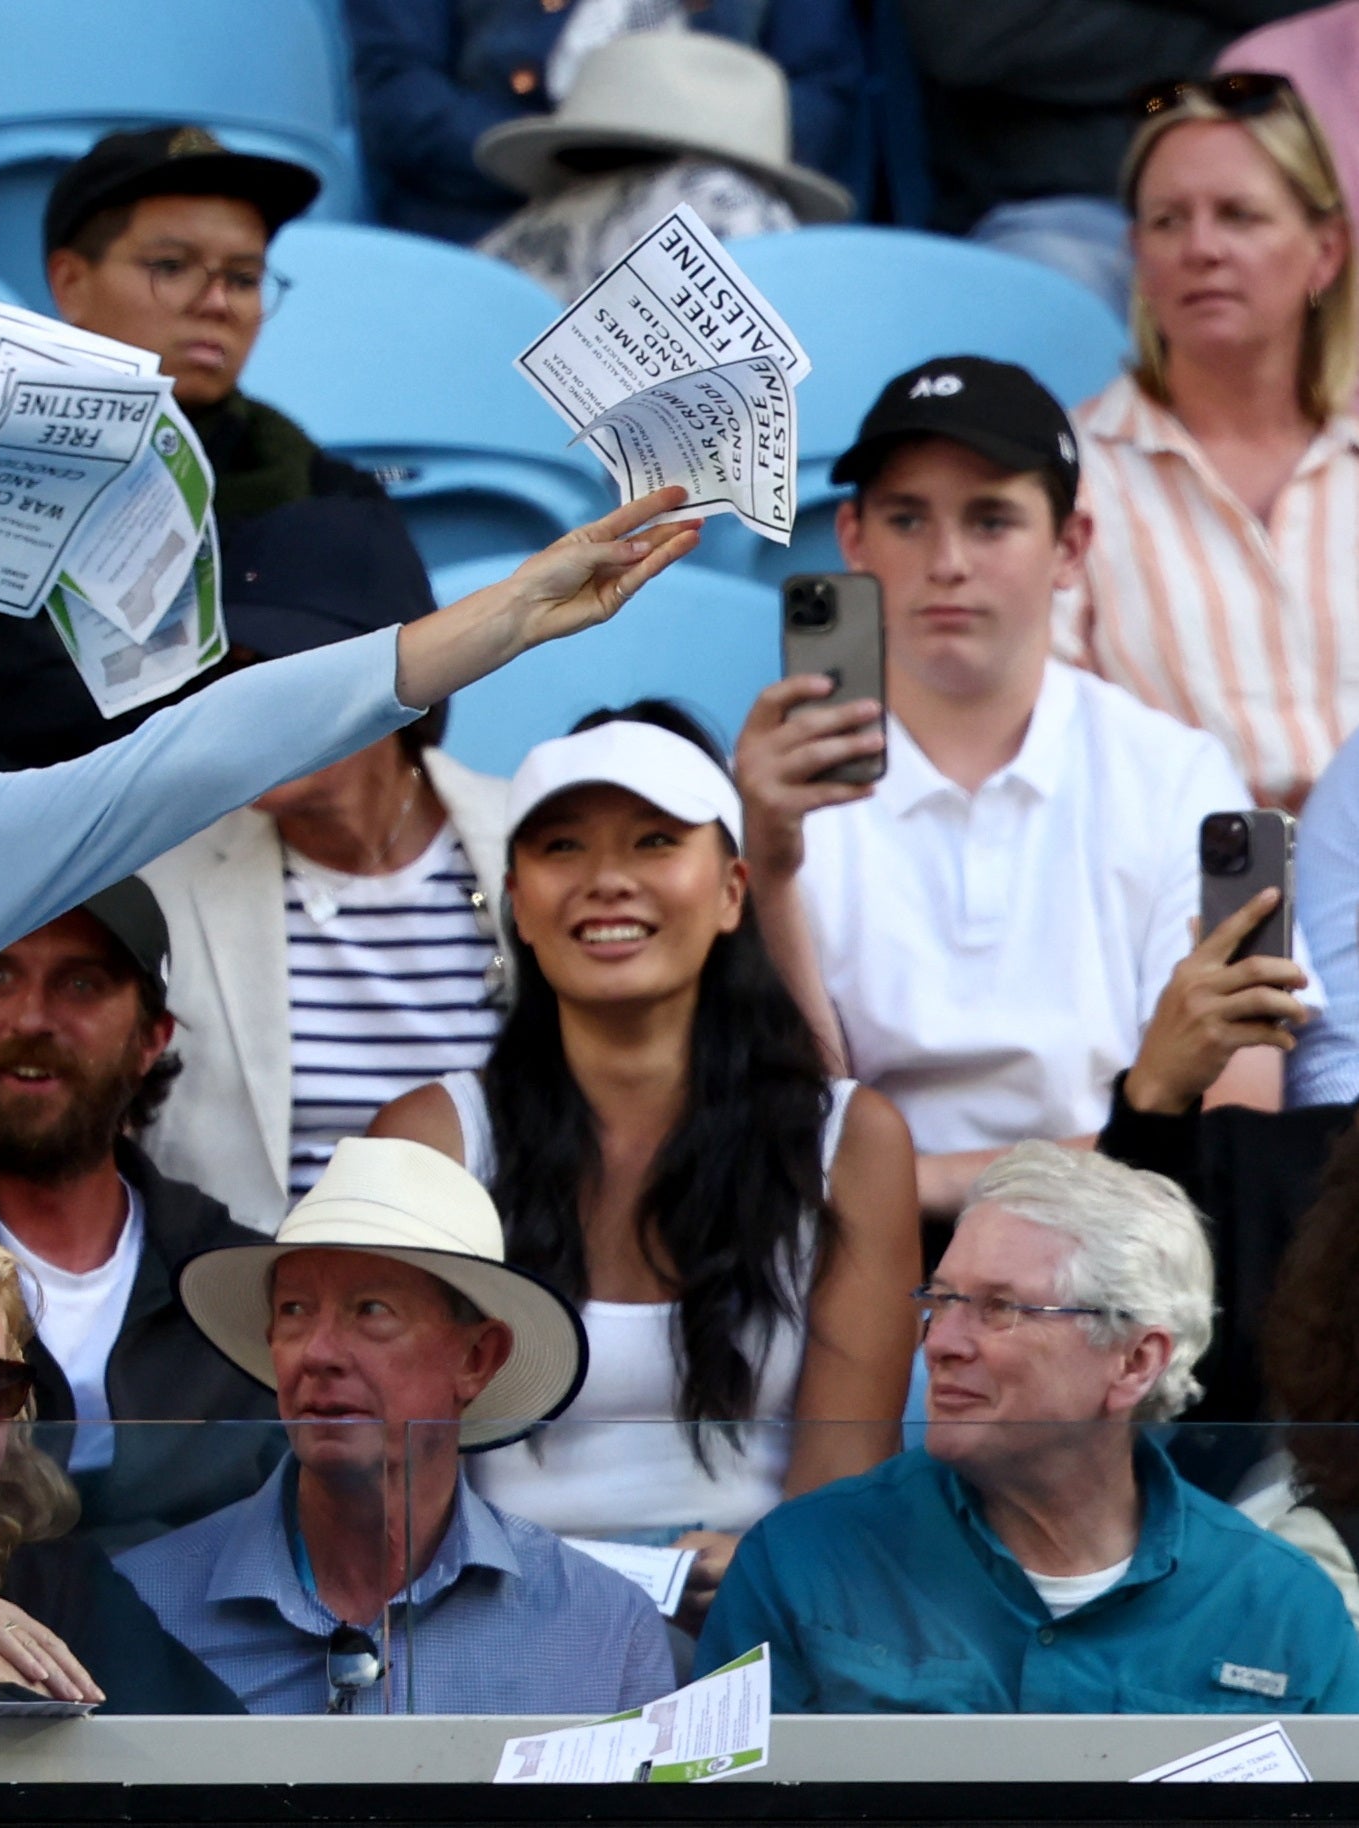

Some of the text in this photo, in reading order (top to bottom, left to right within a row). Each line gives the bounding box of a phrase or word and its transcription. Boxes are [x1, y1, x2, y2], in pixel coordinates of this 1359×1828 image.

[659, 228, 778, 357] ALESTINE
[670, 286, 731, 352] FREE
[594, 308, 661, 378] CRIMES
[643, 333, 685, 373] AND
[552, 353, 574, 375] GAZA
[572, 375, 585, 387] ON
[542, 358, 598, 419] ATCHING TENNIS
[618, 378, 638, 396] LOSE
[908, 374, 964, 399] AO
[16, 392, 148, 422] PALESTINE
[697, 402, 728, 442] AND
[39, 425, 102, 448] FREE
[694, 382, 742, 482] GENOCIDE
[749, 361, 787, 522] PALESTINE
[750, 394, 771, 468] FREE
[653, 462, 665, 487] OMBS
[701, 436, 727, 483] WAR
[19, 496, 65, 521] WAR
